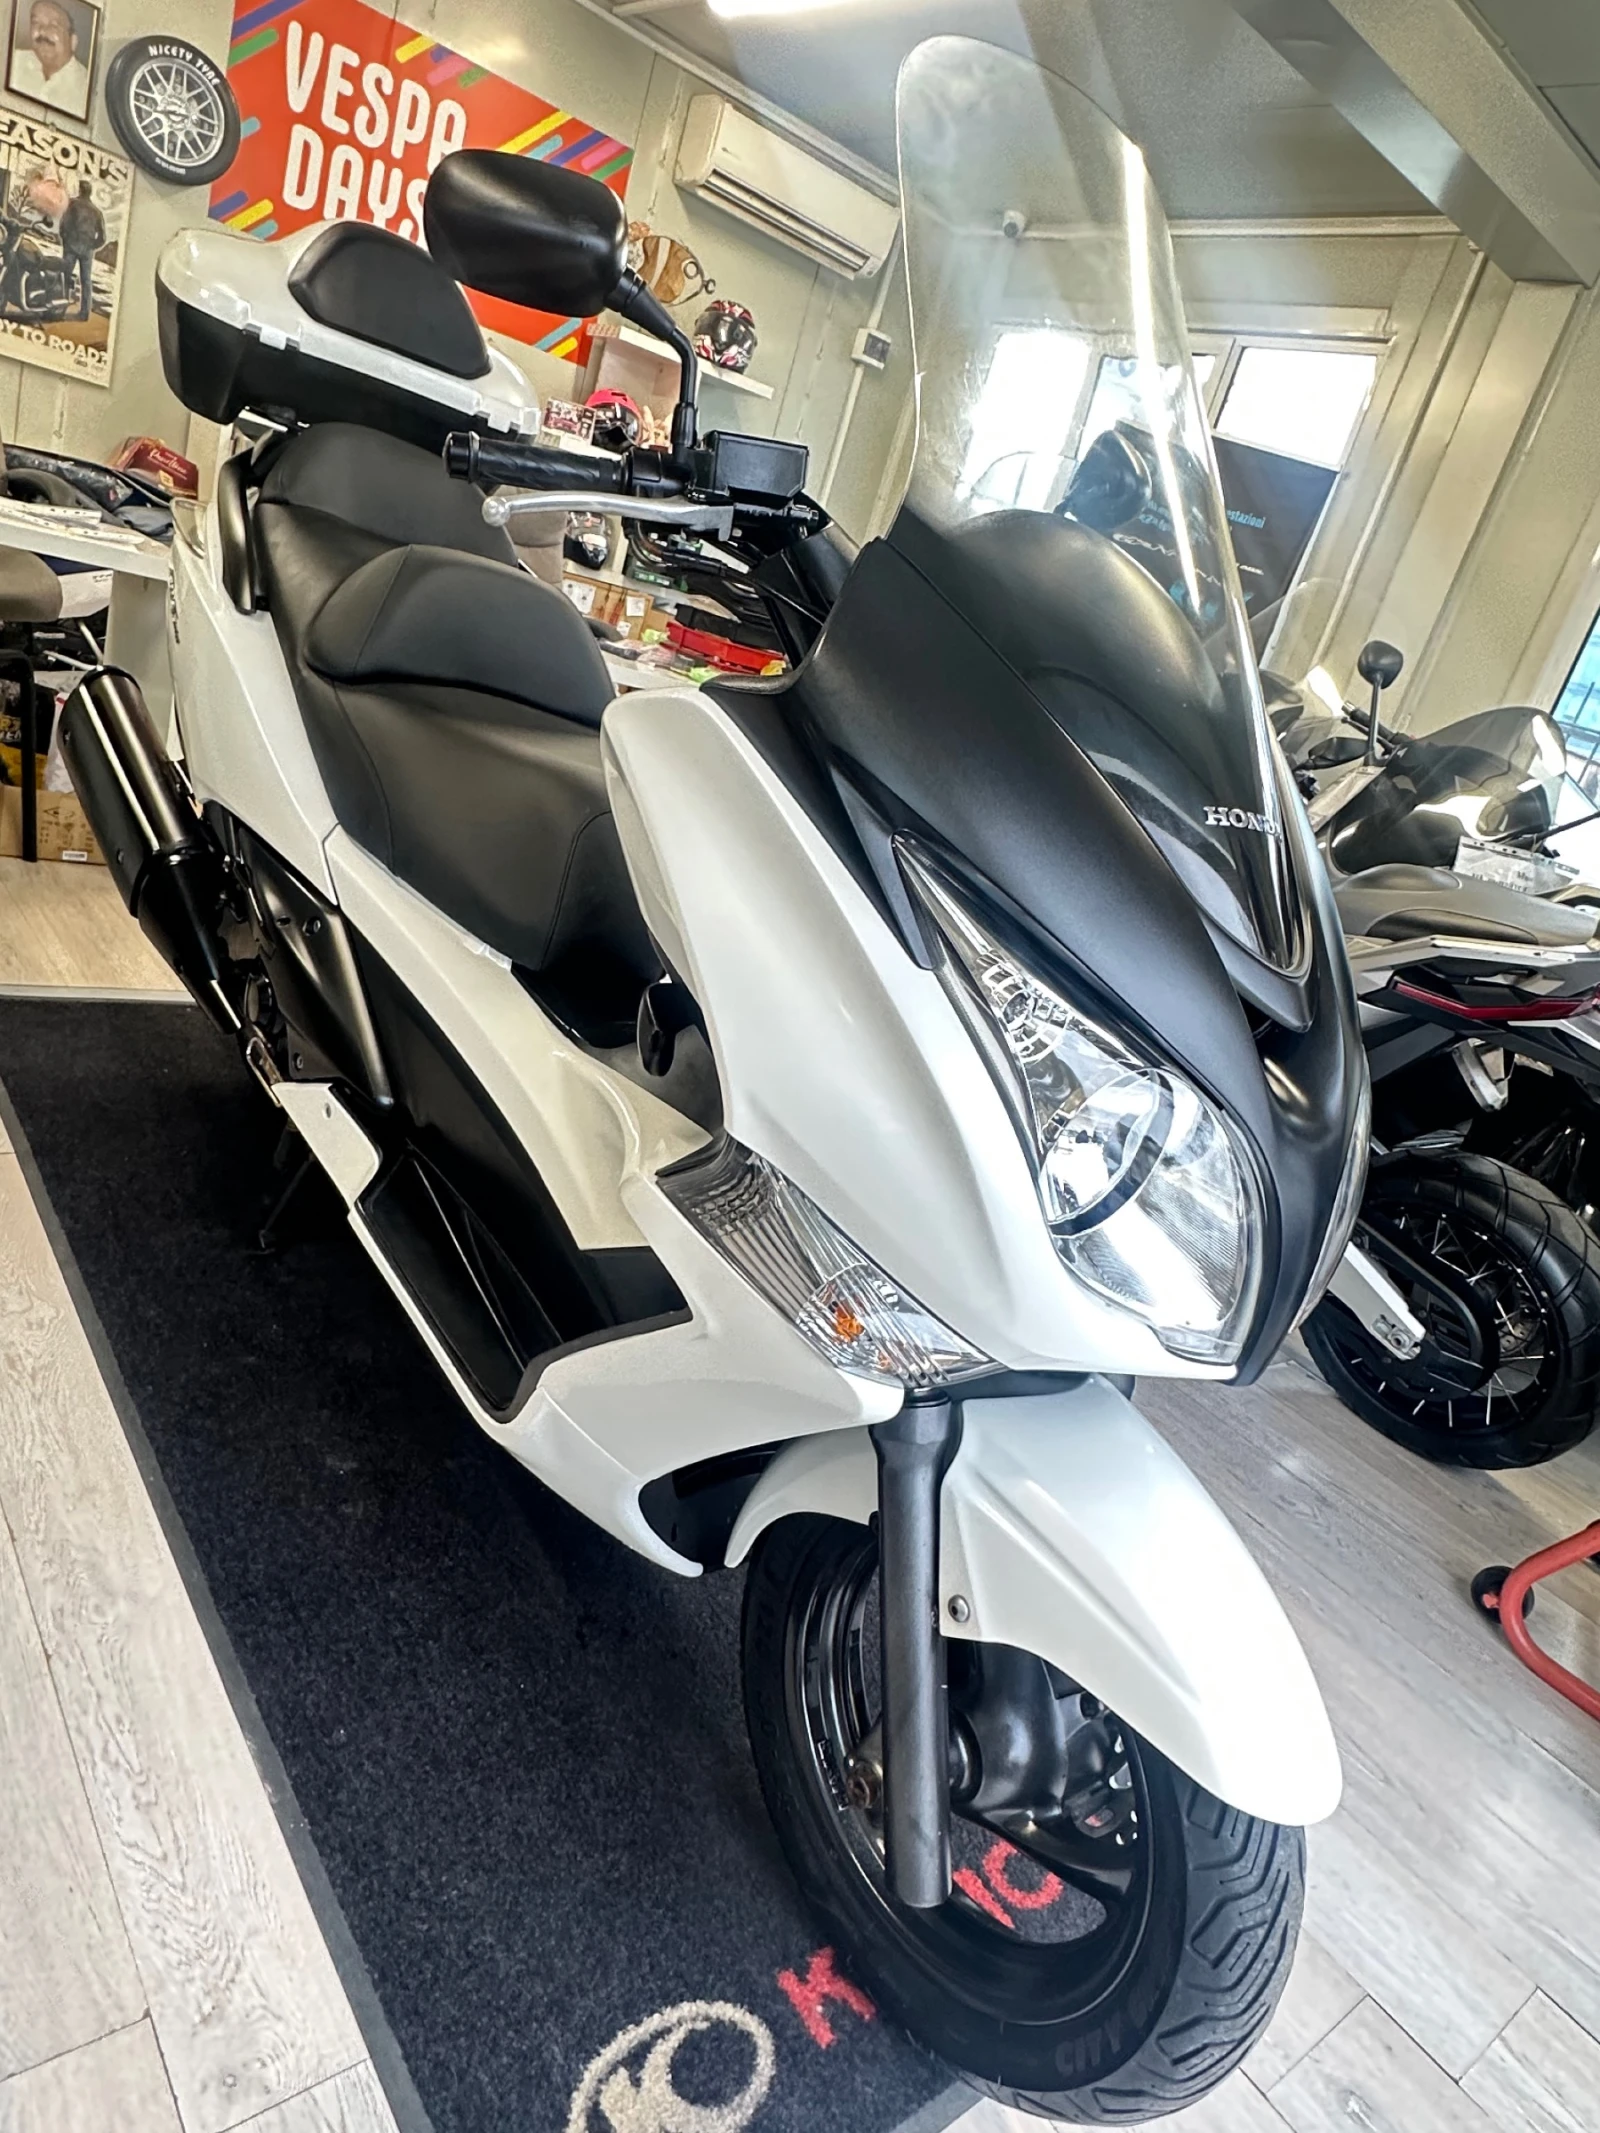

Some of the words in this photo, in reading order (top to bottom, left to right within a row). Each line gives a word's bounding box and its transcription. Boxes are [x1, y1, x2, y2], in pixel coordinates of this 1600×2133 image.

[148, 44, 193, 62] NICETY
[286, 20, 467, 176] VESPA
[282, 123, 428, 249] DAYS
[20, 324, 46, 344] TO
[48, 334, 107, 366] ROAD?
[1055, 2012, 1122, 2076] CITY
